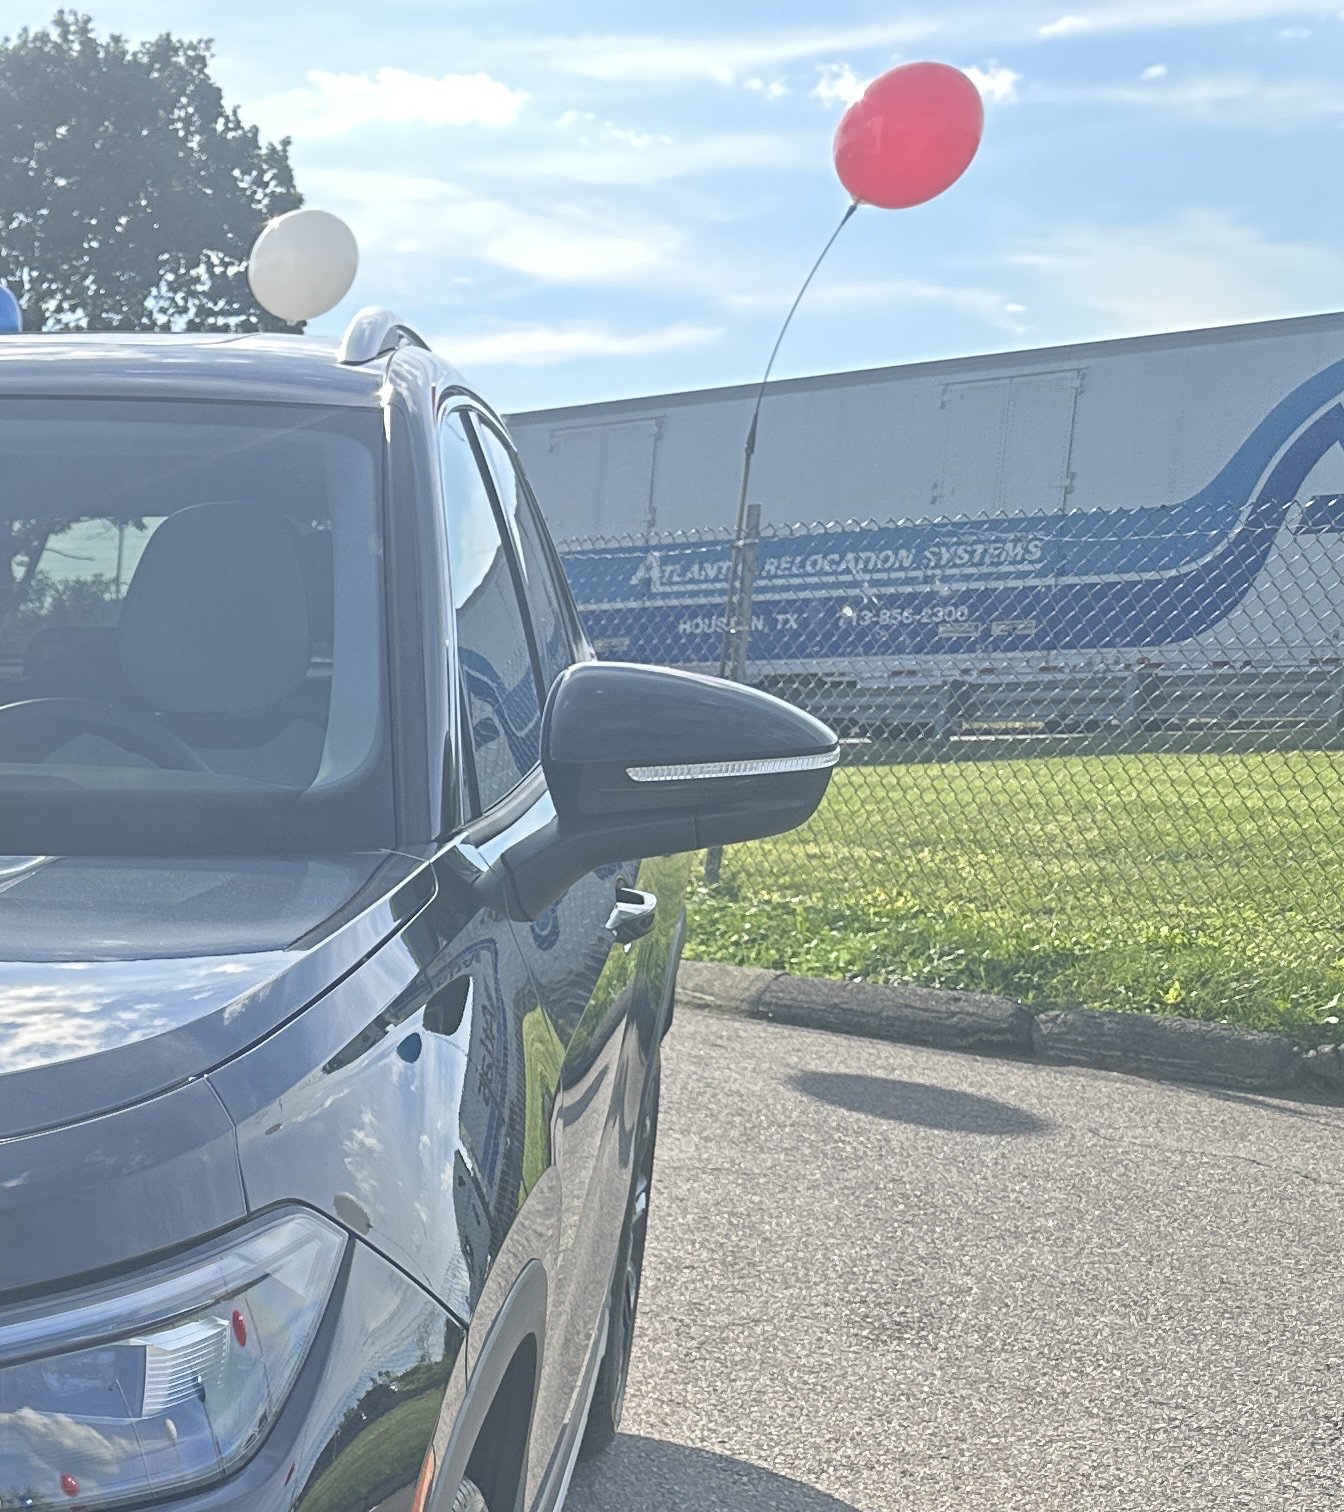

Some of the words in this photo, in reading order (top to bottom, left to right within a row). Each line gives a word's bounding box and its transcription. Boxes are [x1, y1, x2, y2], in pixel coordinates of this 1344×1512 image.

[629, 551, 758, 593] ATLANTI
[761, 550, 913, 576] RELOCATION
[923, 539, 1043, 566] SYSTEMS
[678, 615, 769, 634] HOUSTN,
[776, 613, 798, 630] TX
